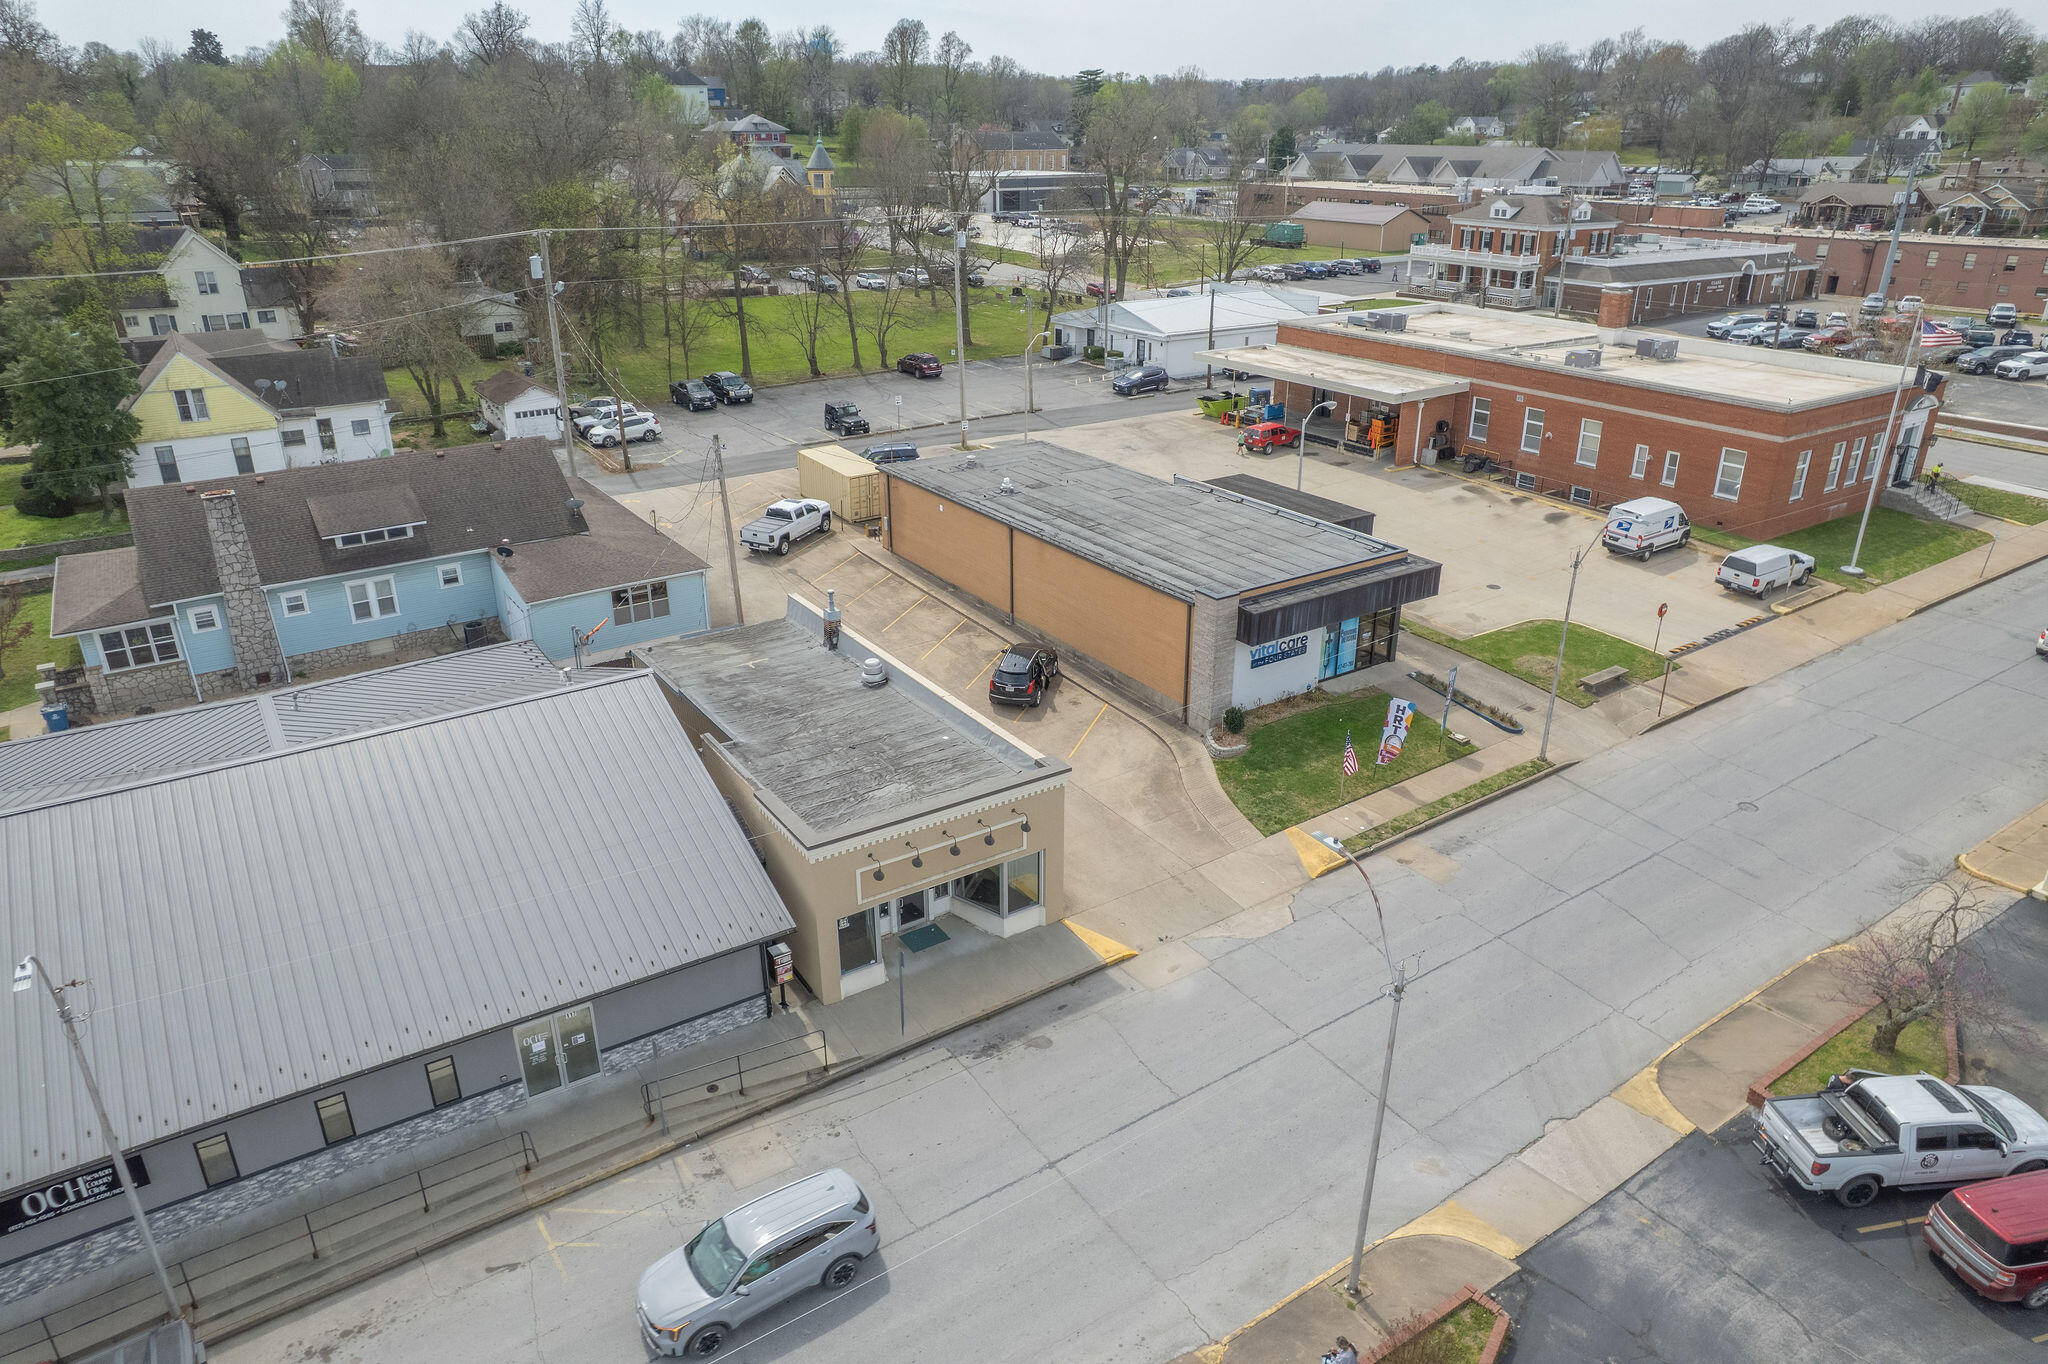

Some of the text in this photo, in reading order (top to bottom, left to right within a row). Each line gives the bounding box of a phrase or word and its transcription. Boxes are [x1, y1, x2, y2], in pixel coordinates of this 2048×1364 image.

[1265, 653, 1283, 663] FOUR
[1284, 647, 1306, 660] STATES
[1393, 704, 1407, 735] HRT
[83, 1168, 113, 1182] Newton
[86, 1176, 113, 1189] County
[21, 1176, 89, 1217] OCH
[88, 1184, 109, 1196] Clinic
